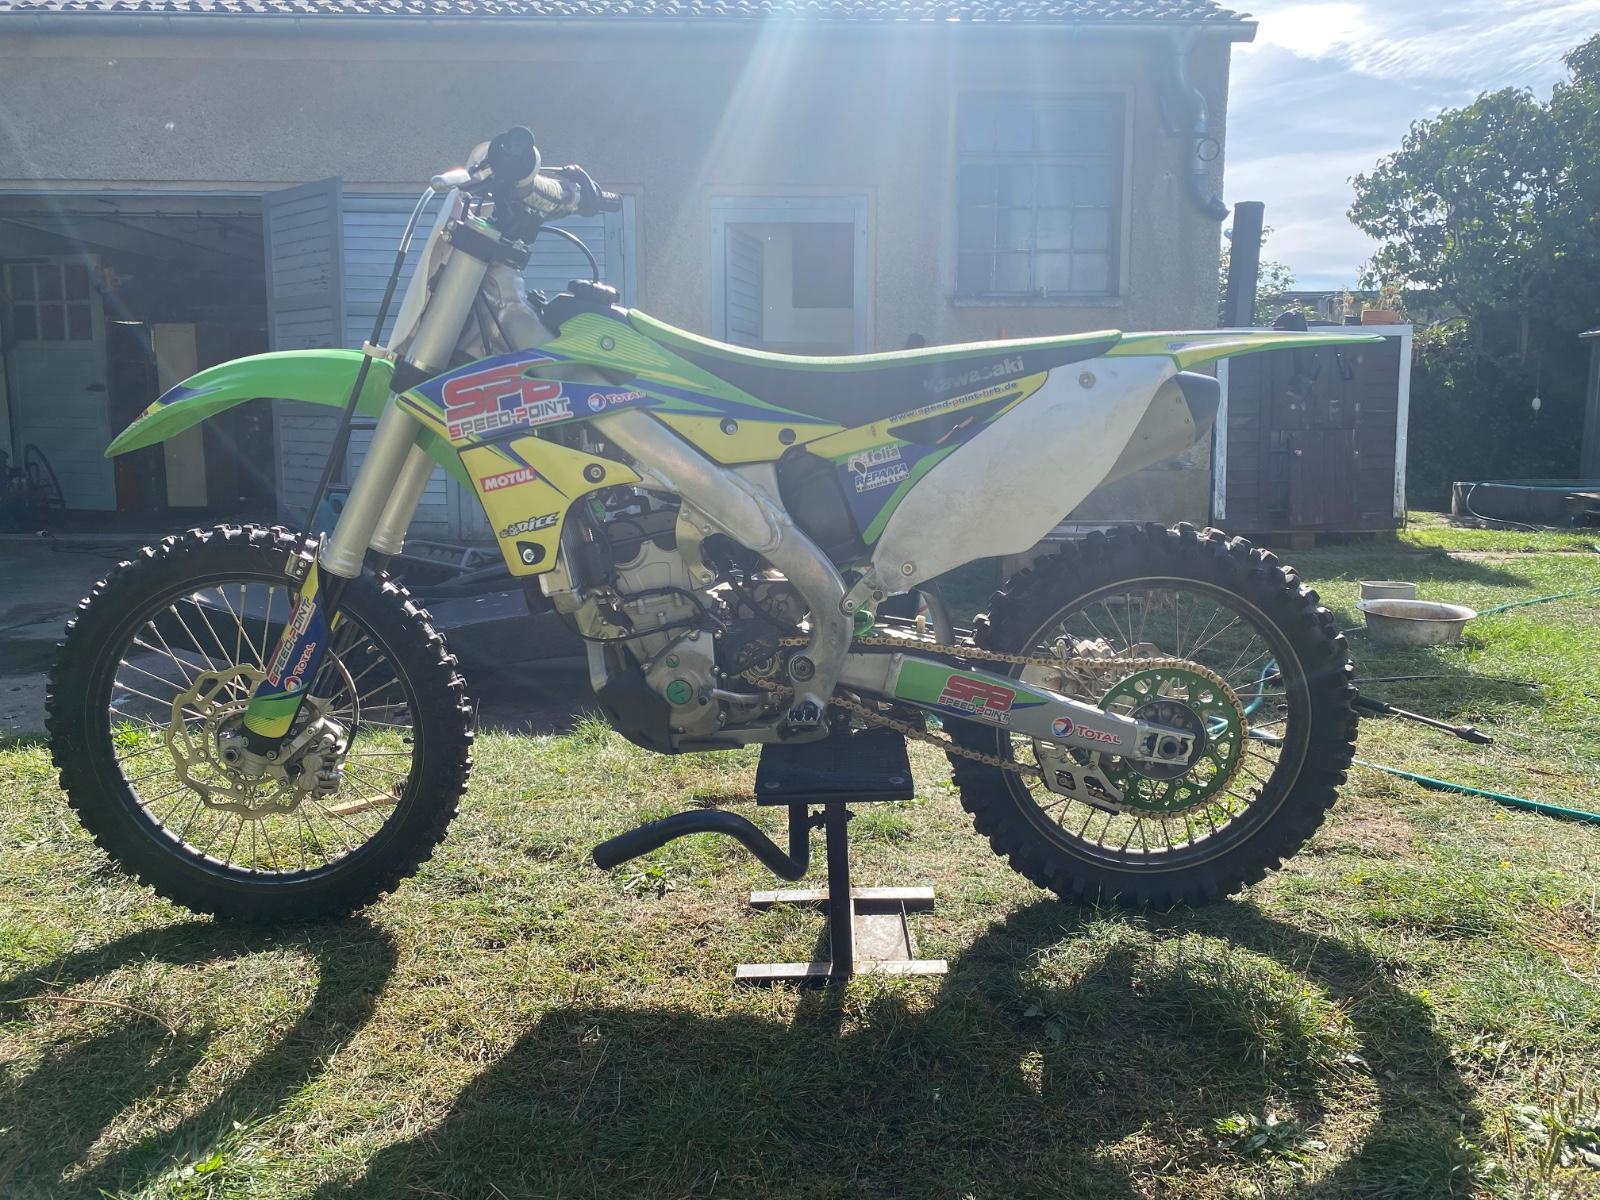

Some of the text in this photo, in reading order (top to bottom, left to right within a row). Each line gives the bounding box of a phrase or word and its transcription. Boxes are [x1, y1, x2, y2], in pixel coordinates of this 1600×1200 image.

[922, 356, 1024, 392] Kawasaki
[606, 391, 647, 405] TOTAL
[447, 398, 570, 440] SPEED-POINT
[867, 447, 899, 463] folia
[484, 468, 534, 491] MOTUL
[854, 463, 908, 486] REPAMA
[268, 597, 311, 687] SPEED-POINT
[293, 643, 316, 676] TOTAL
[941, 675, 1016, 712] SPB
[938, 695, 1010, 722] SPEED-POINT
[1077, 725, 1122, 745] TOTAL
